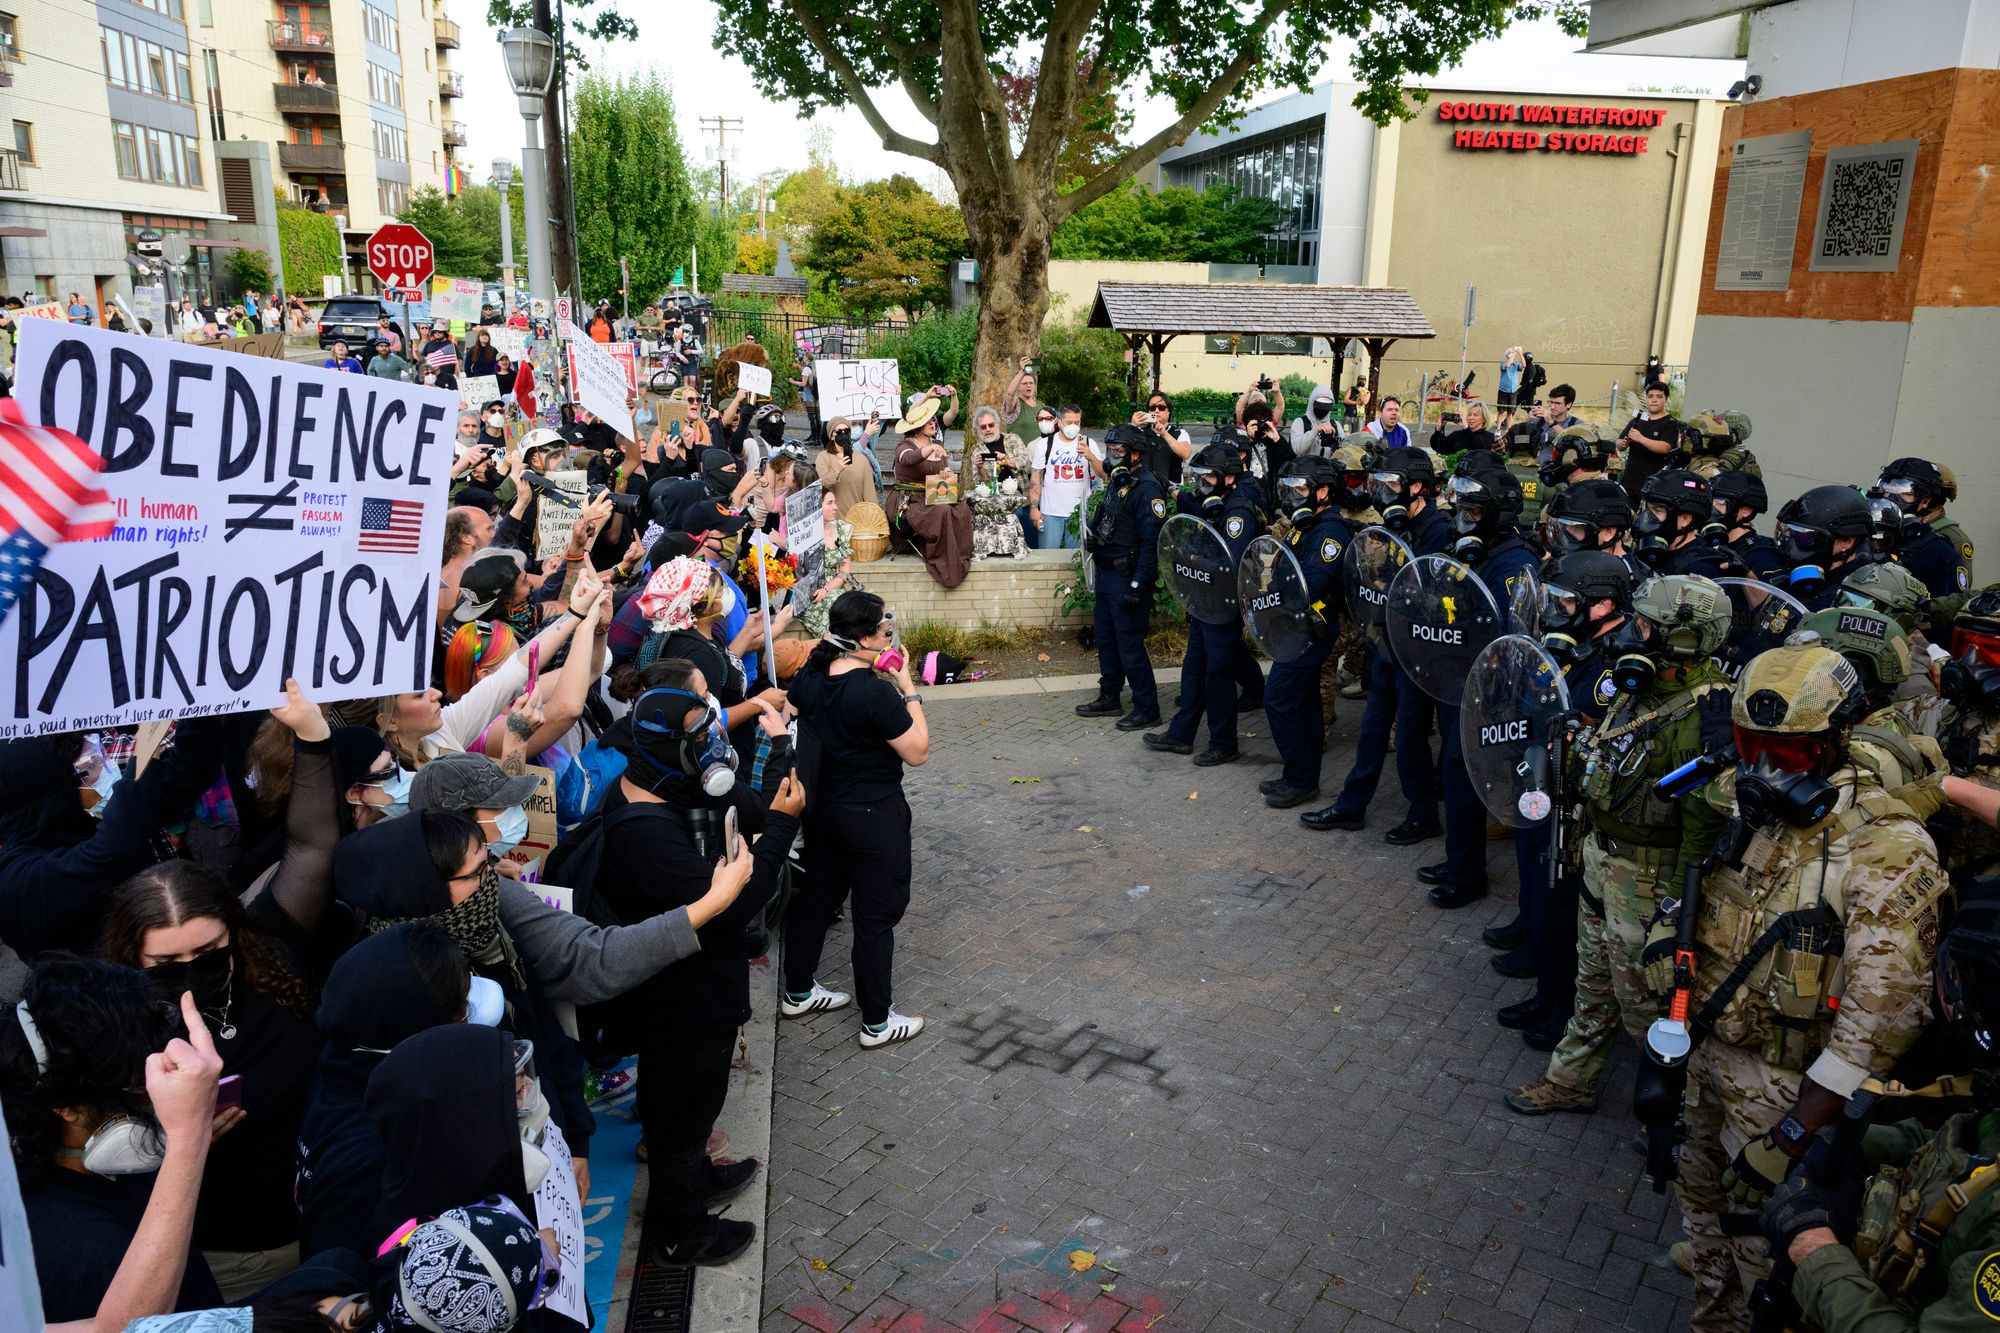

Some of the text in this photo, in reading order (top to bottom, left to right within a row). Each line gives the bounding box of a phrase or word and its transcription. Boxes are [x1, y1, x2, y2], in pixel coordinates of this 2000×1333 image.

[1439, 102, 1667, 127] SOUTH WATERFRONT
[1455, 130, 1649, 153] HEATED STORAGE
[372, 244, 429, 269] STOP
[464, 382, 484, 393] STOP
[839, 361, 898, 394] FUCK
[40, 339, 446, 487] OBEDIENCE
[836, 392, 895, 417] ICE!
[1051, 450, 1083, 465] Fuck
[1053, 464, 1084, 480] ICE
[562, 481, 582, 490] STATE
[141, 496, 198, 521] human
[303, 492, 348, 506] PROTEST
[301, 509, 343, 522] FASCISM
[156, 524, 208, 549] rights!
[788, 526, 801, 537] WILL
[1176, 563, 1211, 584] POLICE
[1252, 592, 1281, 612] POLICE
[1359, 586, 1388, 606] POLIC
[14, 551, 430, 719] PATRIOTISM
[1412, 624, 1463, 645] POLICE
[1841, 615, 1885, 637] POLICE
[24, 723, 35, 736] a
[39, 717, 67, 736] paid
[158, 708, 174, 719] an
[179, 704, 211, 718] angry
[213, 697, 241, 716] girl!
[1482, 720, 1528, 745] POLICE
[546, 1179, 580, 1231] EPSTEIN
[553, 1218, 579, 1265] FILES!
